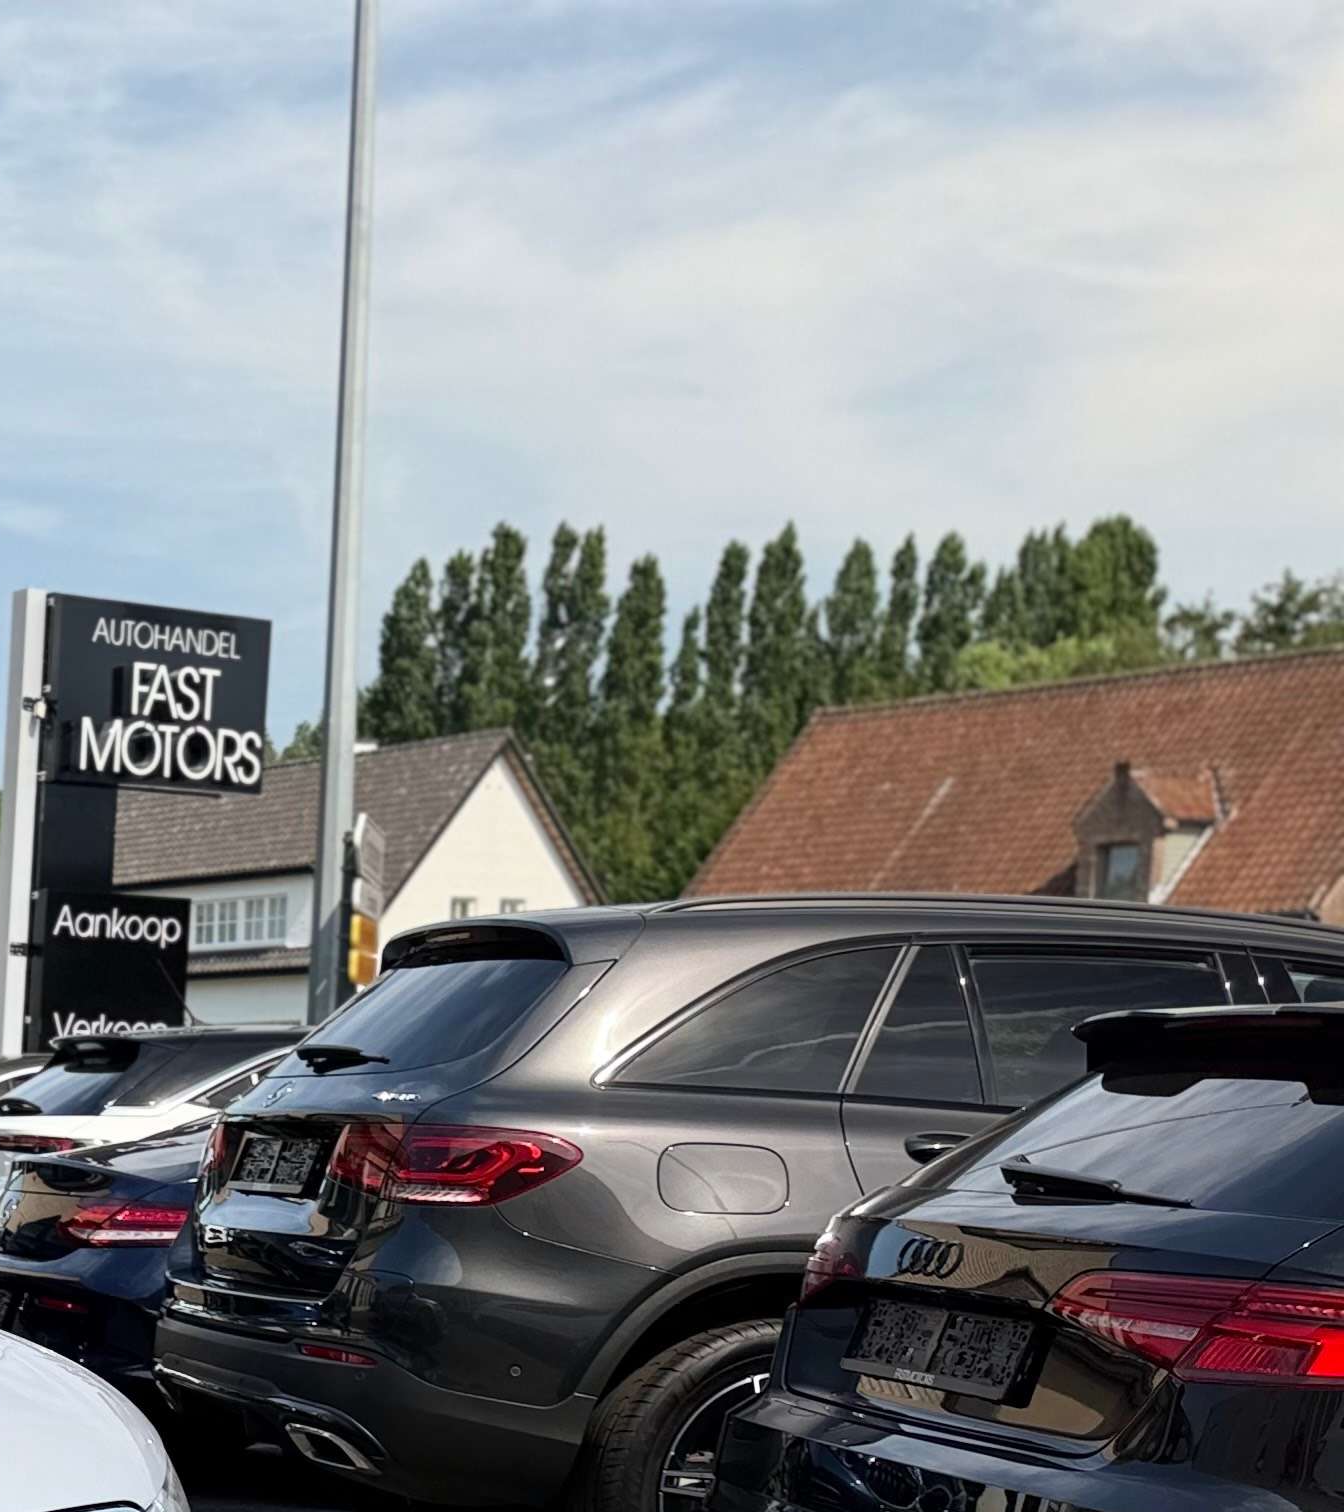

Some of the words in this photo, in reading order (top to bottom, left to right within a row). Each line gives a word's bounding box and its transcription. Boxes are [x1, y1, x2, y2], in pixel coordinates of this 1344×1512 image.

[92, 617, 242, 660] AUTOHANDEL
[130, 661, 221, 722] FAST
[78, 716, 263, 785] MOTORS
[53, 904, 182, 949] Aankoop
